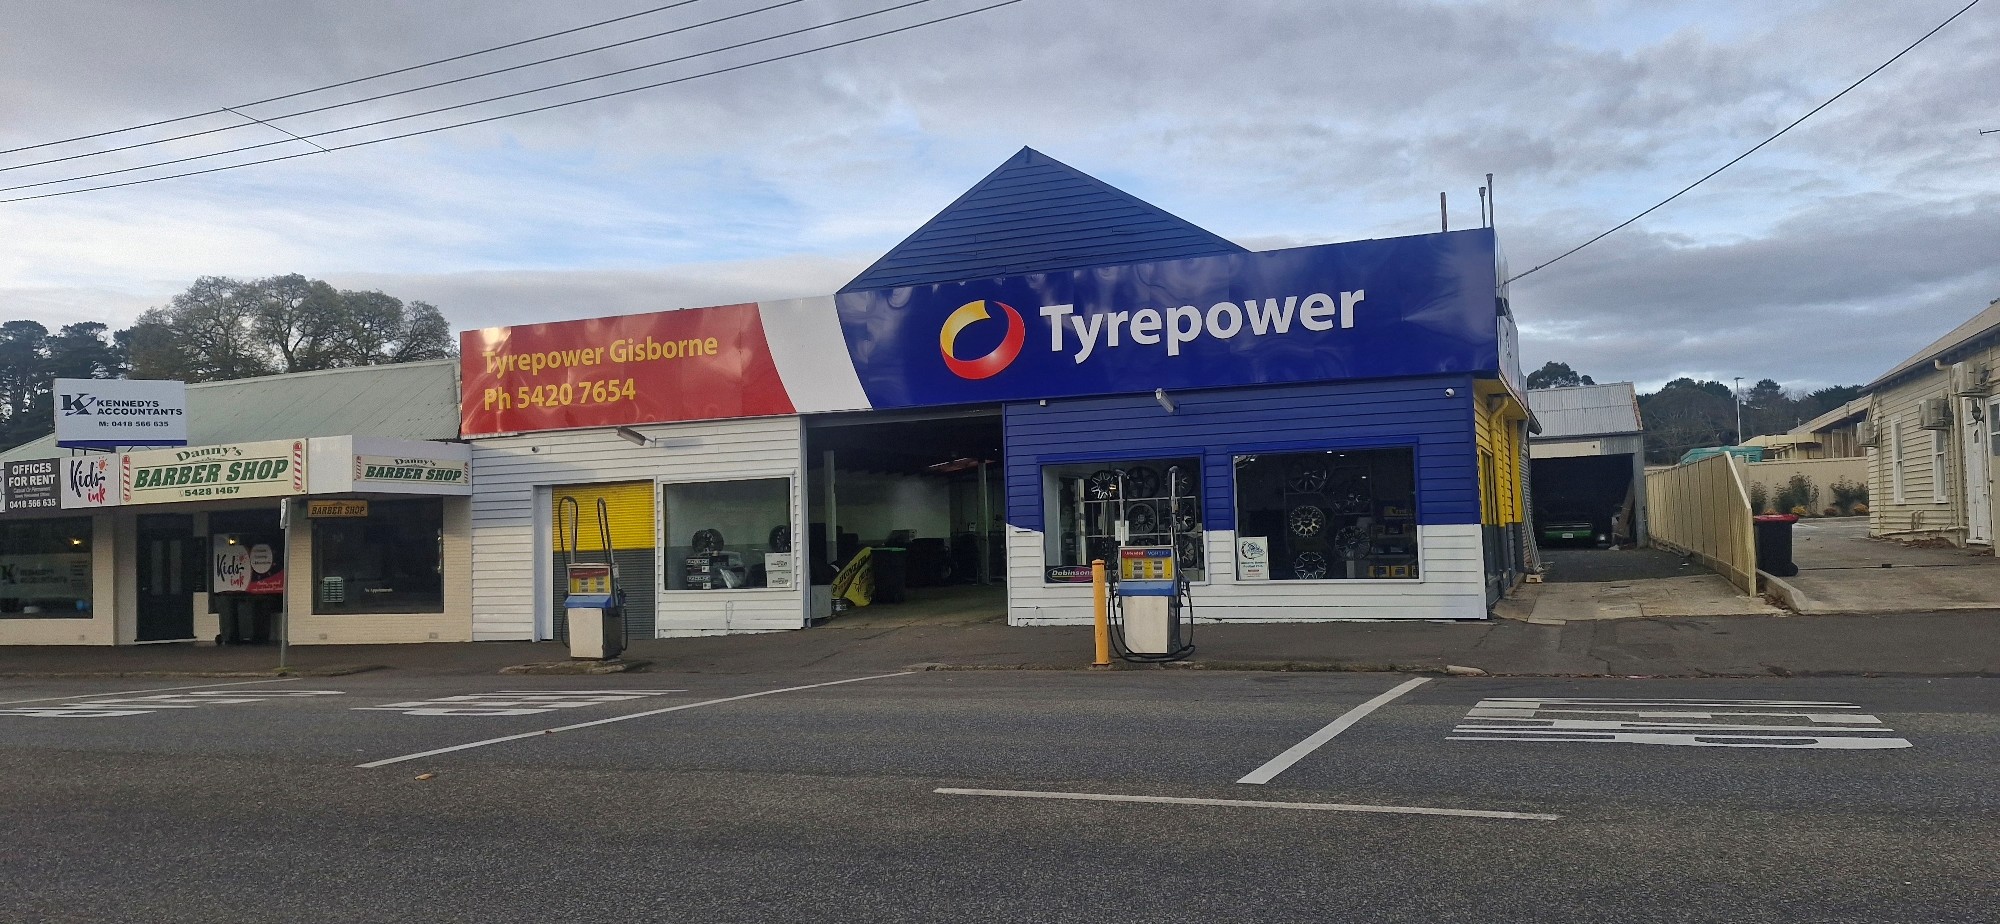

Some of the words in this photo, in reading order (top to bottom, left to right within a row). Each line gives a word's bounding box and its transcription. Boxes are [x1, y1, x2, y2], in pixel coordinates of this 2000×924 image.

[1040, 289, 1365, 364] Tyrepower
[482, 345, 604, 378] Tyrepower
[610, 336, 718, 363] Gisborne
[484, 386, 511, 410] Ph
[517, 382, 573, 409] 5420
[579, 378, 636, 404] 7654
[97, 400, 159, 408] KENNEDYS
[97, 408, 183, 416] ACCOUNTANTS
[176, 446, 243, 462] Danny's
[12, 463, 52, 475] OFFICES
[394, 458, 437, 467] Danny's
[8, 476, 28, 487] FOR
[30, 474, 56, 486] RENT
[70, 460, 105, 498] Kids
[134, 463, 222, 488] BARBER
[226, 459, 289, 482] SHOP
[364, 466, 424, 480] BARBER
[425, 468, 462, 481] SHOP
[88, 483, 106, 504] ink
[184, 487, 212, 497] 5428
[215, 486, 240, 495] 1467
[9, 500, 27, 509] 0418
[28, 499, 41, 508] 566
[42, 498, 56, 507] 635
[311, 506, 343, 515] BARBER
[344, 505, 365, 514] SHOP
[216, 553, 244, 582] Kids
